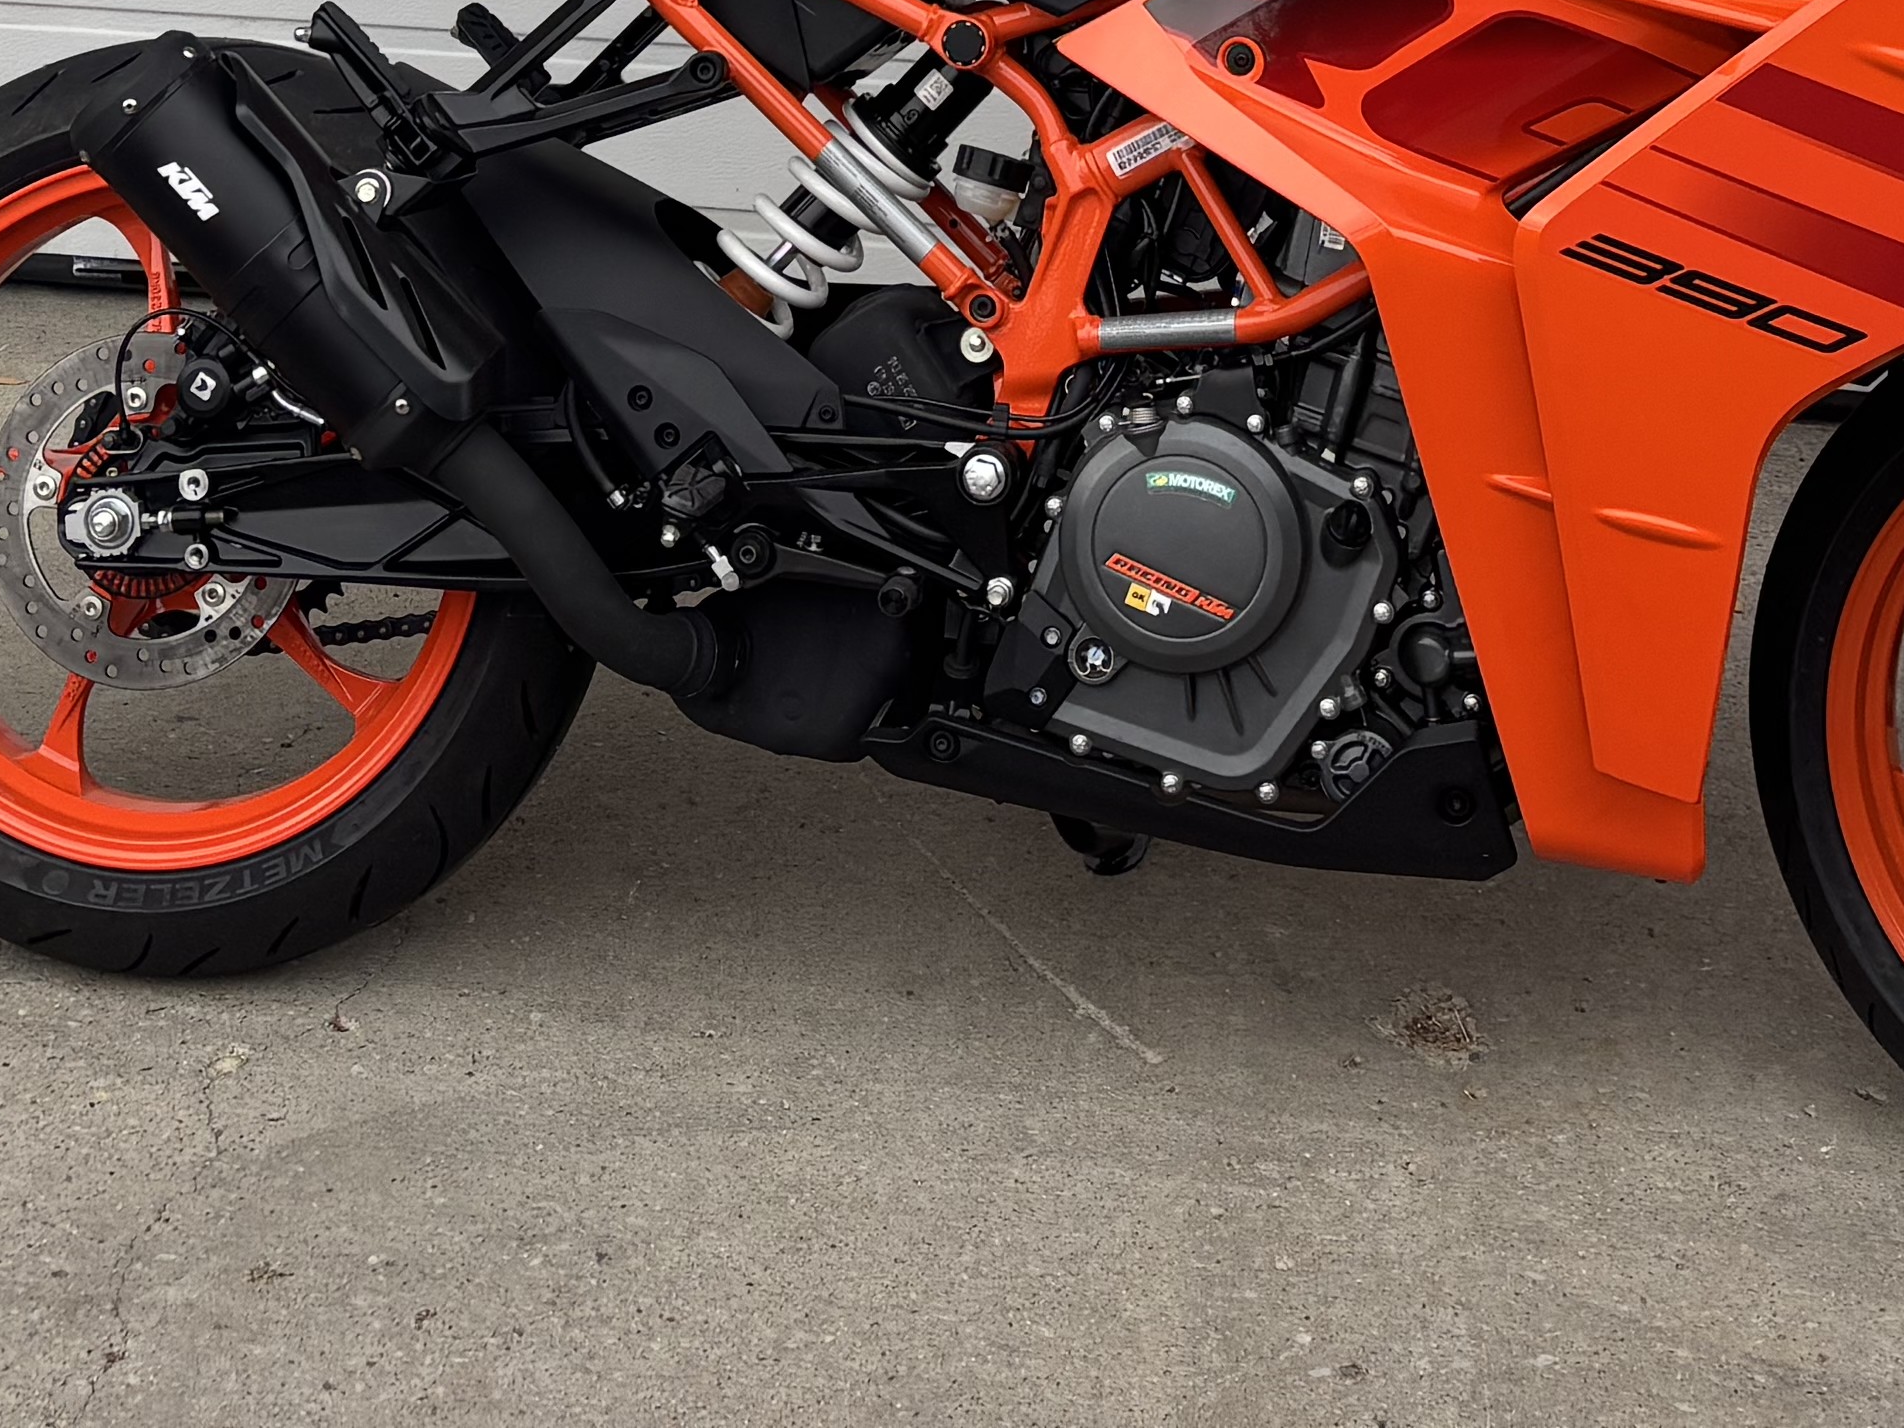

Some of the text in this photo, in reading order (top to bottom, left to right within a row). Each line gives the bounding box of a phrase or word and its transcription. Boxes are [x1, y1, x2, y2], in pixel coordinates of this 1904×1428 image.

[156, 161, 220, 222] KTM
[1558, 232, 1869, 354] 390
[1167, 472, 1232, 503] MOTOREX
[1112, 557, 1193, 599] RACING
[86, 838, 325, 907] METZELER
